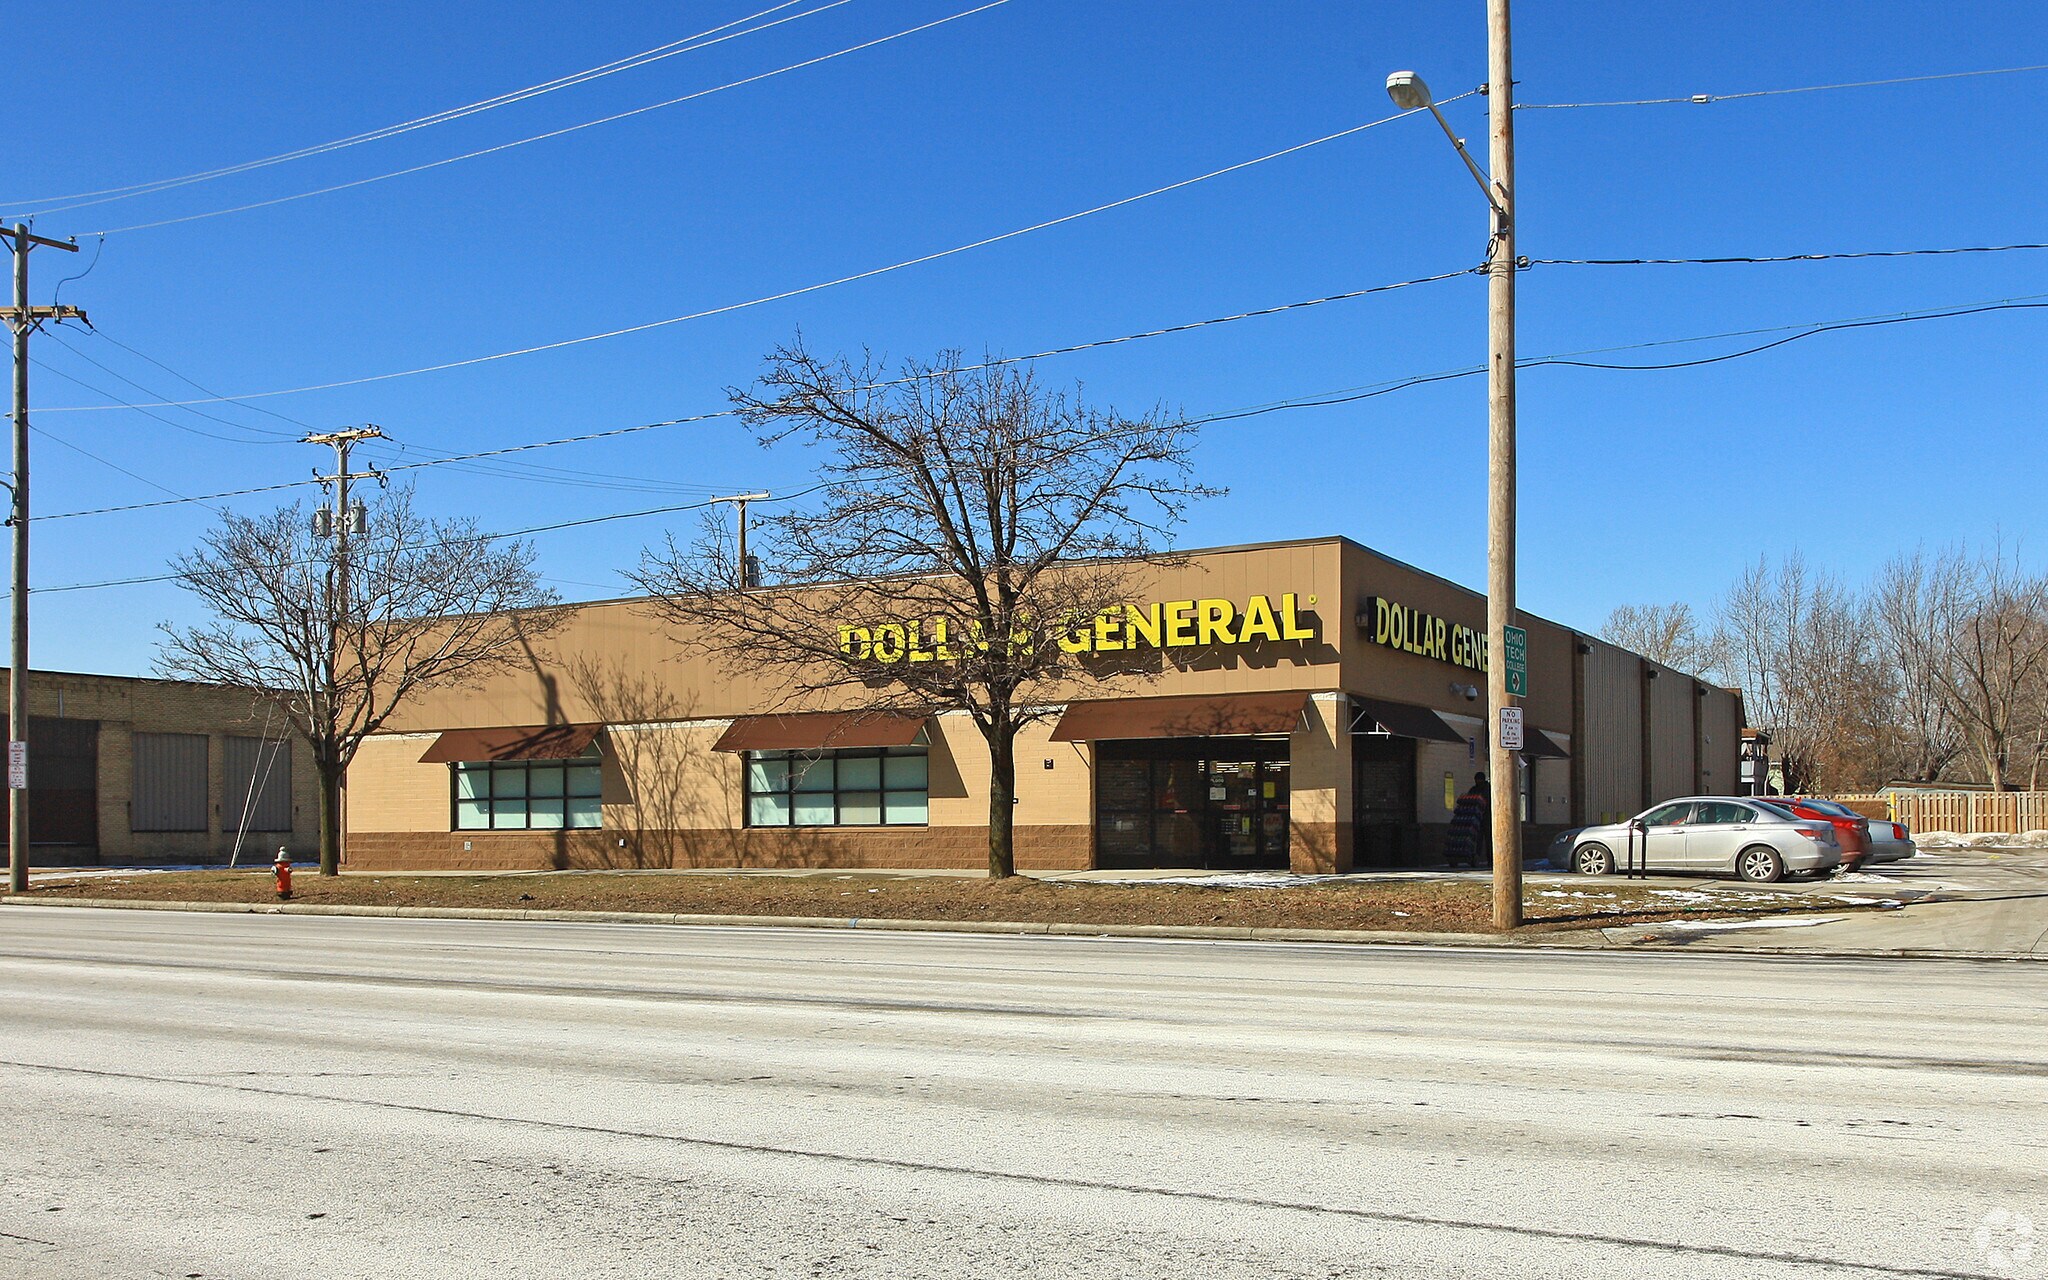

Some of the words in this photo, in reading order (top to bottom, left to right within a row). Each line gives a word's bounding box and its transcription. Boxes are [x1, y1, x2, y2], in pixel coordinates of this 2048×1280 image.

[1052, 592, 1314, 654] GENERAL
[1376, 596, 1447, 662] DOLLAR
[1451, 623, 1489, 673] GENE
[1505, 631, 1524, 646] OHIO
[1505, 645, 1525, 662] TECH
[1506, 660, 1525, 673] COLLEGE
[1502, 717, 1520, 725] PARKING
